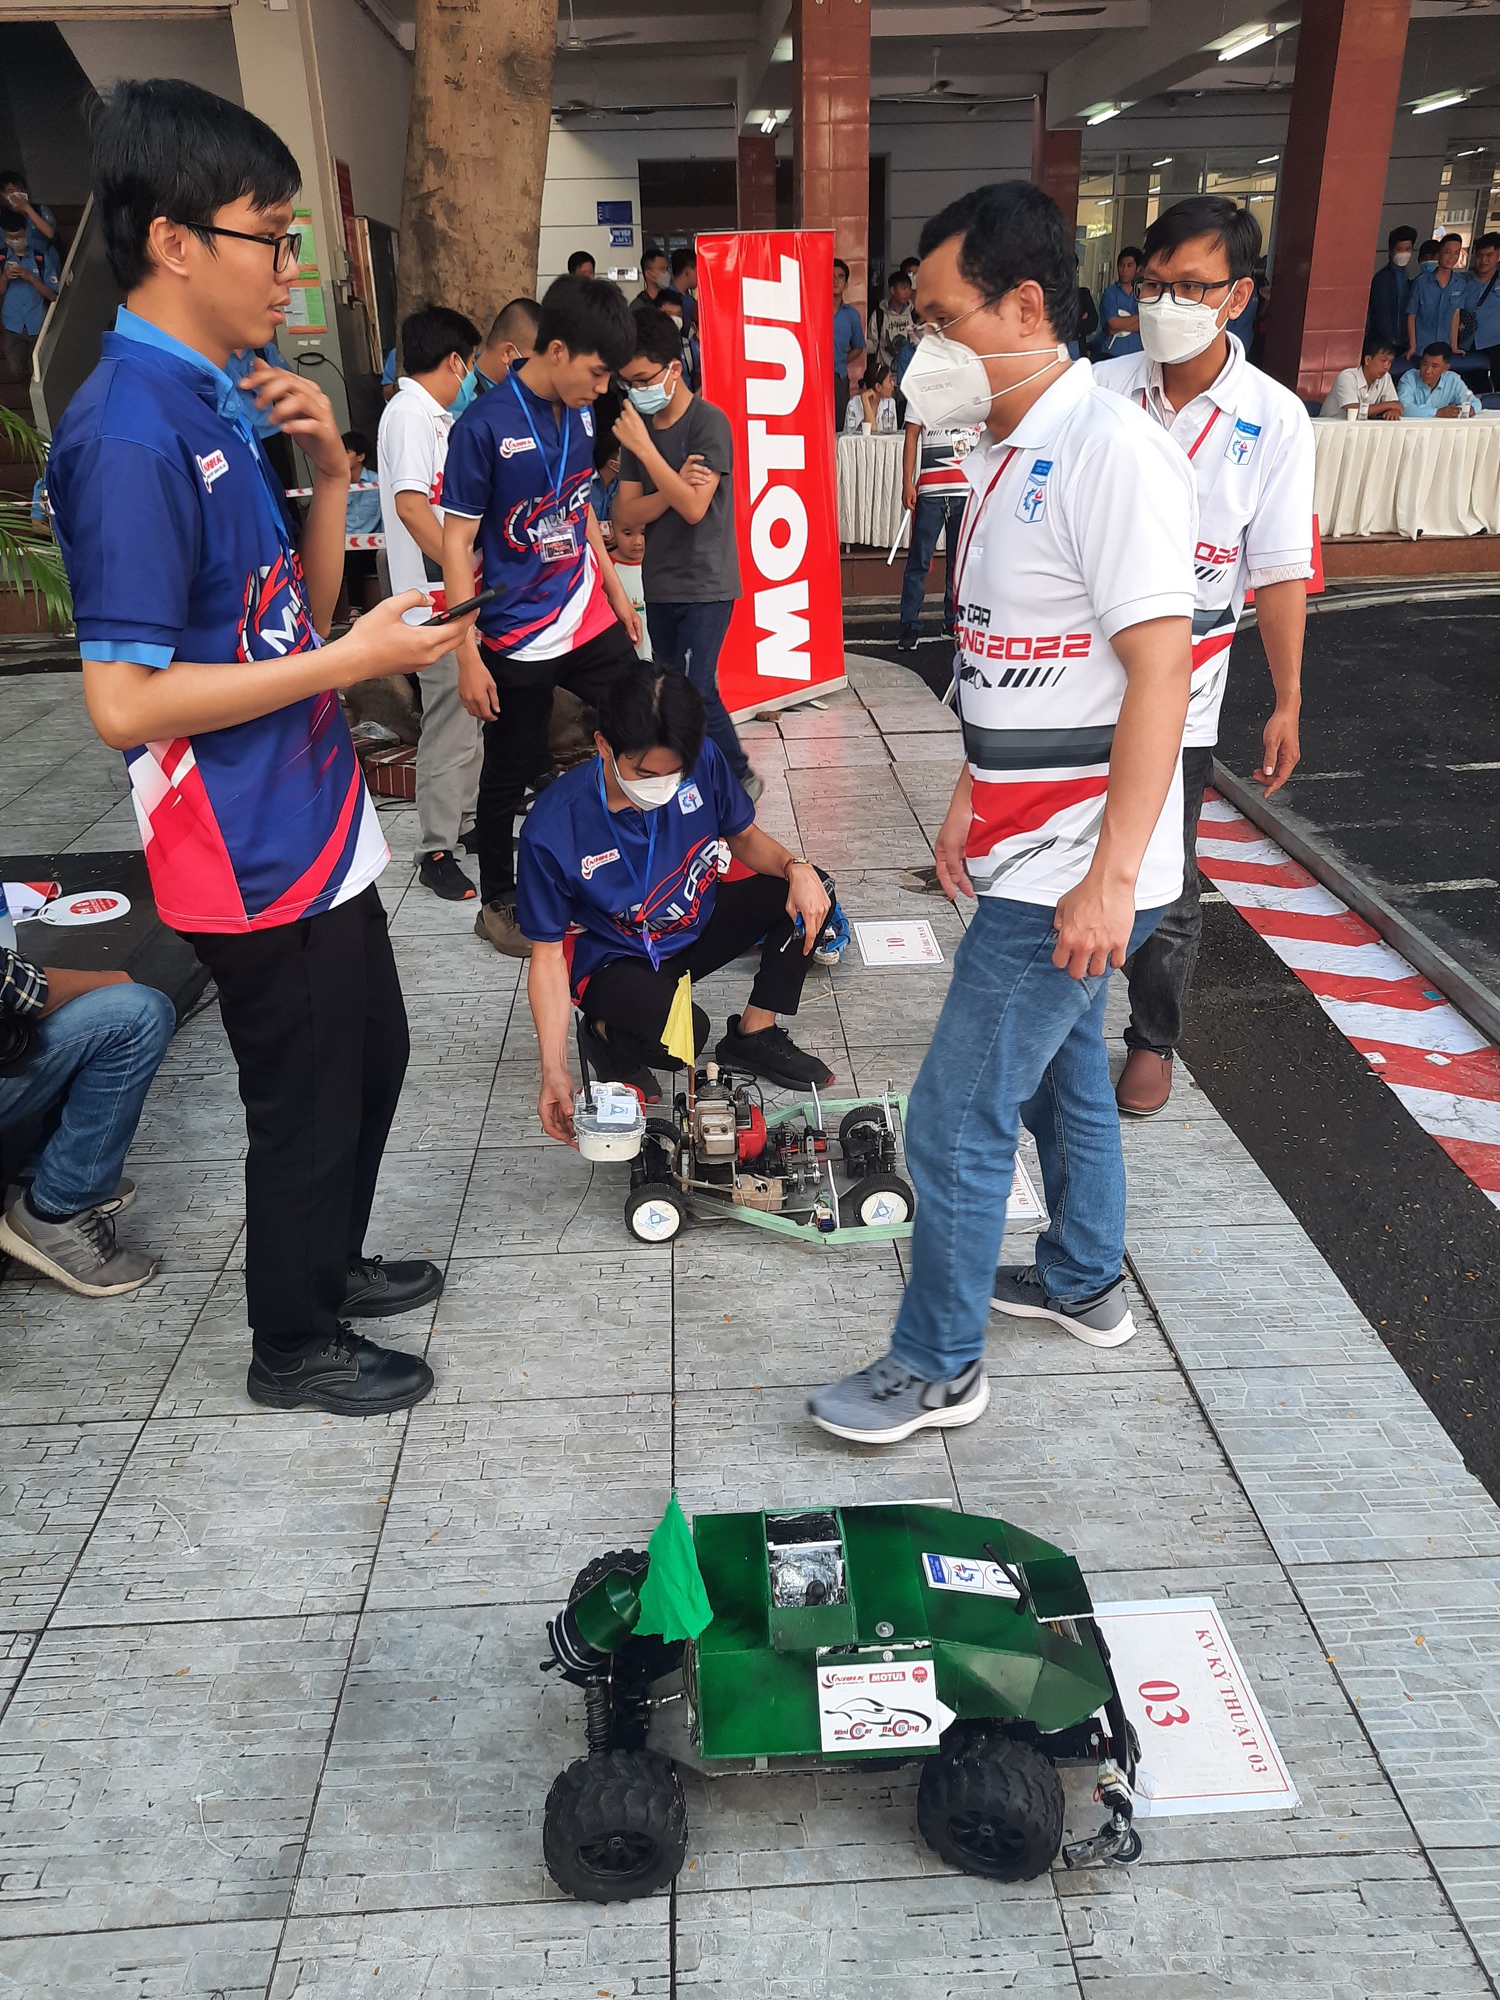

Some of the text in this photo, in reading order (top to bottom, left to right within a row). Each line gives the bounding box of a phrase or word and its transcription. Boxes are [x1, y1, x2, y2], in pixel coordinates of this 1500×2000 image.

[742, 254, 811, 681] MOTUL
[569, 472, 597, 511] CA
[967, 603, 992, 628] CAR
[986, 633, 1092, 661] 2022
[684, 840, 719, 902] CAR
[871, 1672, 904, 1683] MOTUL
[1138, 1680, 1190, 1727] 03
[1195, 1629, 1218, 1653] KV
[1220, 1686, 1258, 1750] THUẬT
[1247, 1754, 1268, 1773] 03
[849, 1722, 873, 1740] Car
